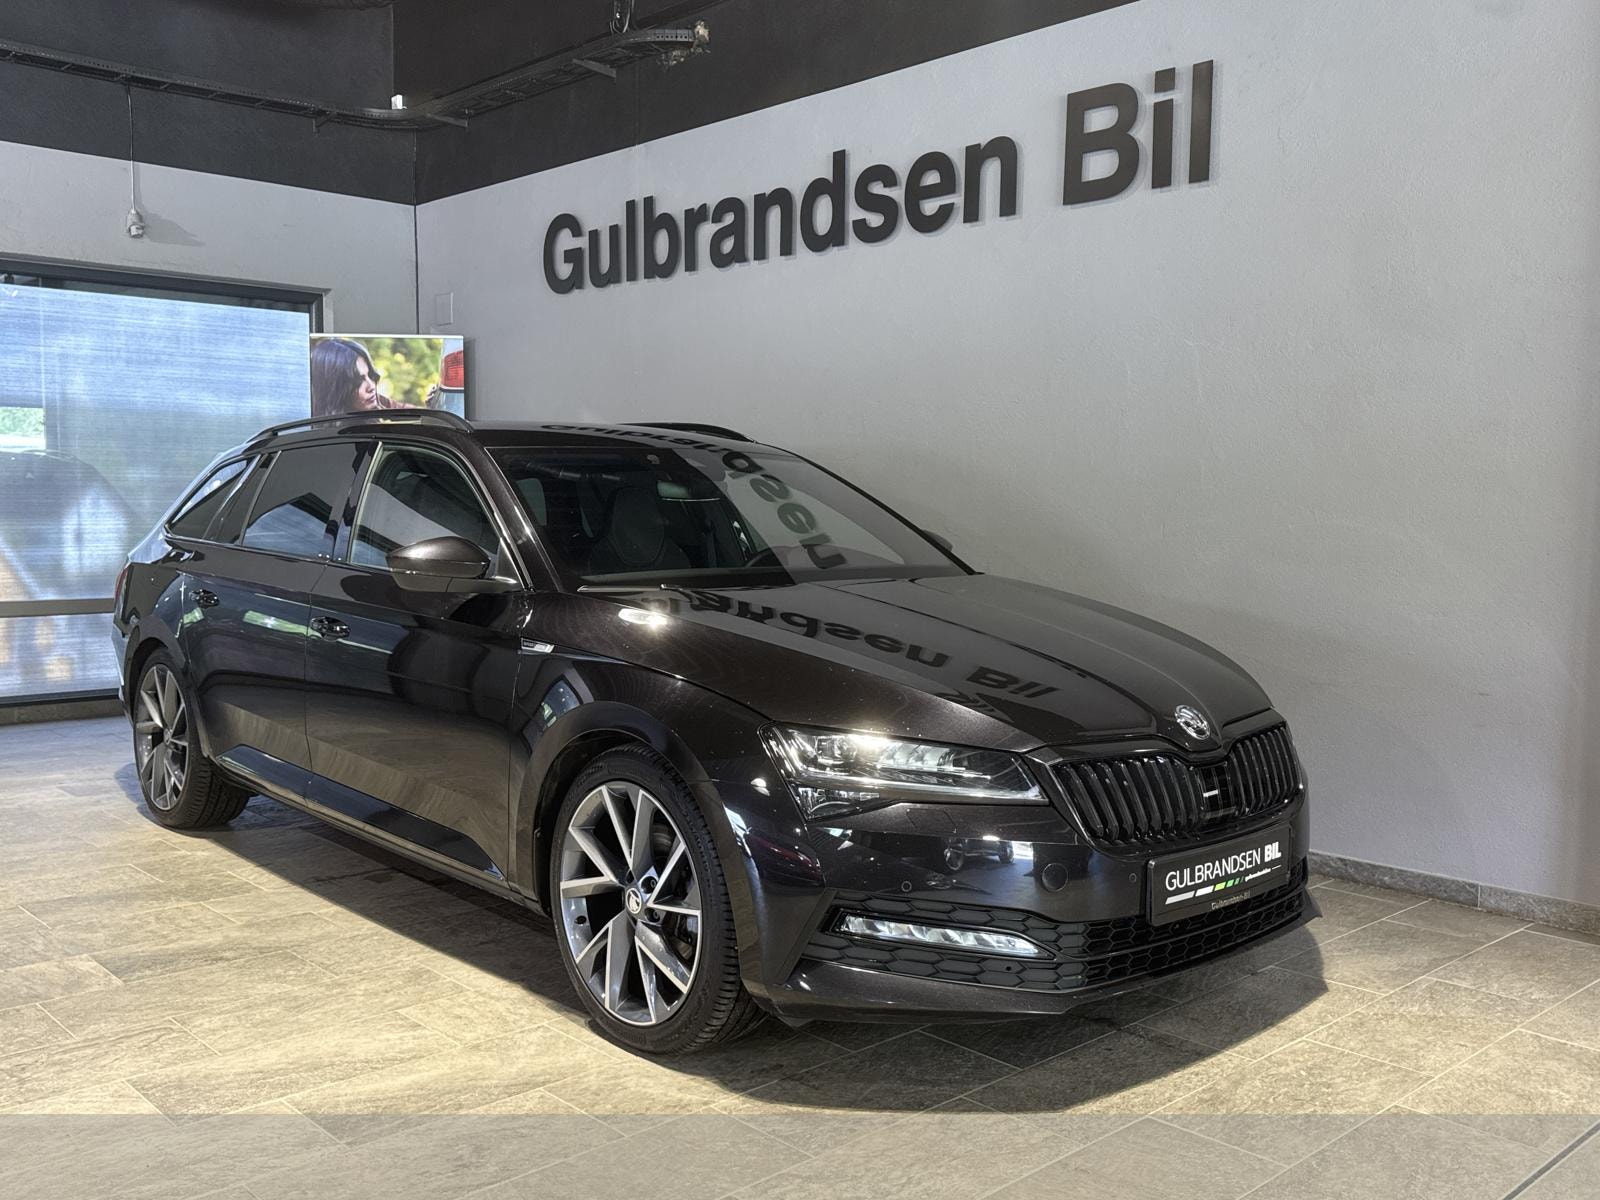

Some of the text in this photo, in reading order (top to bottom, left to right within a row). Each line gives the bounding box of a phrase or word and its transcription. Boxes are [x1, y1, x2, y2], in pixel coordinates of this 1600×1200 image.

[542, 60, 1214, 294] Gulbrandsen Bil
[1165, 848, 1261, 891] GULBRANDSEN
[1264, 841, 1281, 862] BIL
